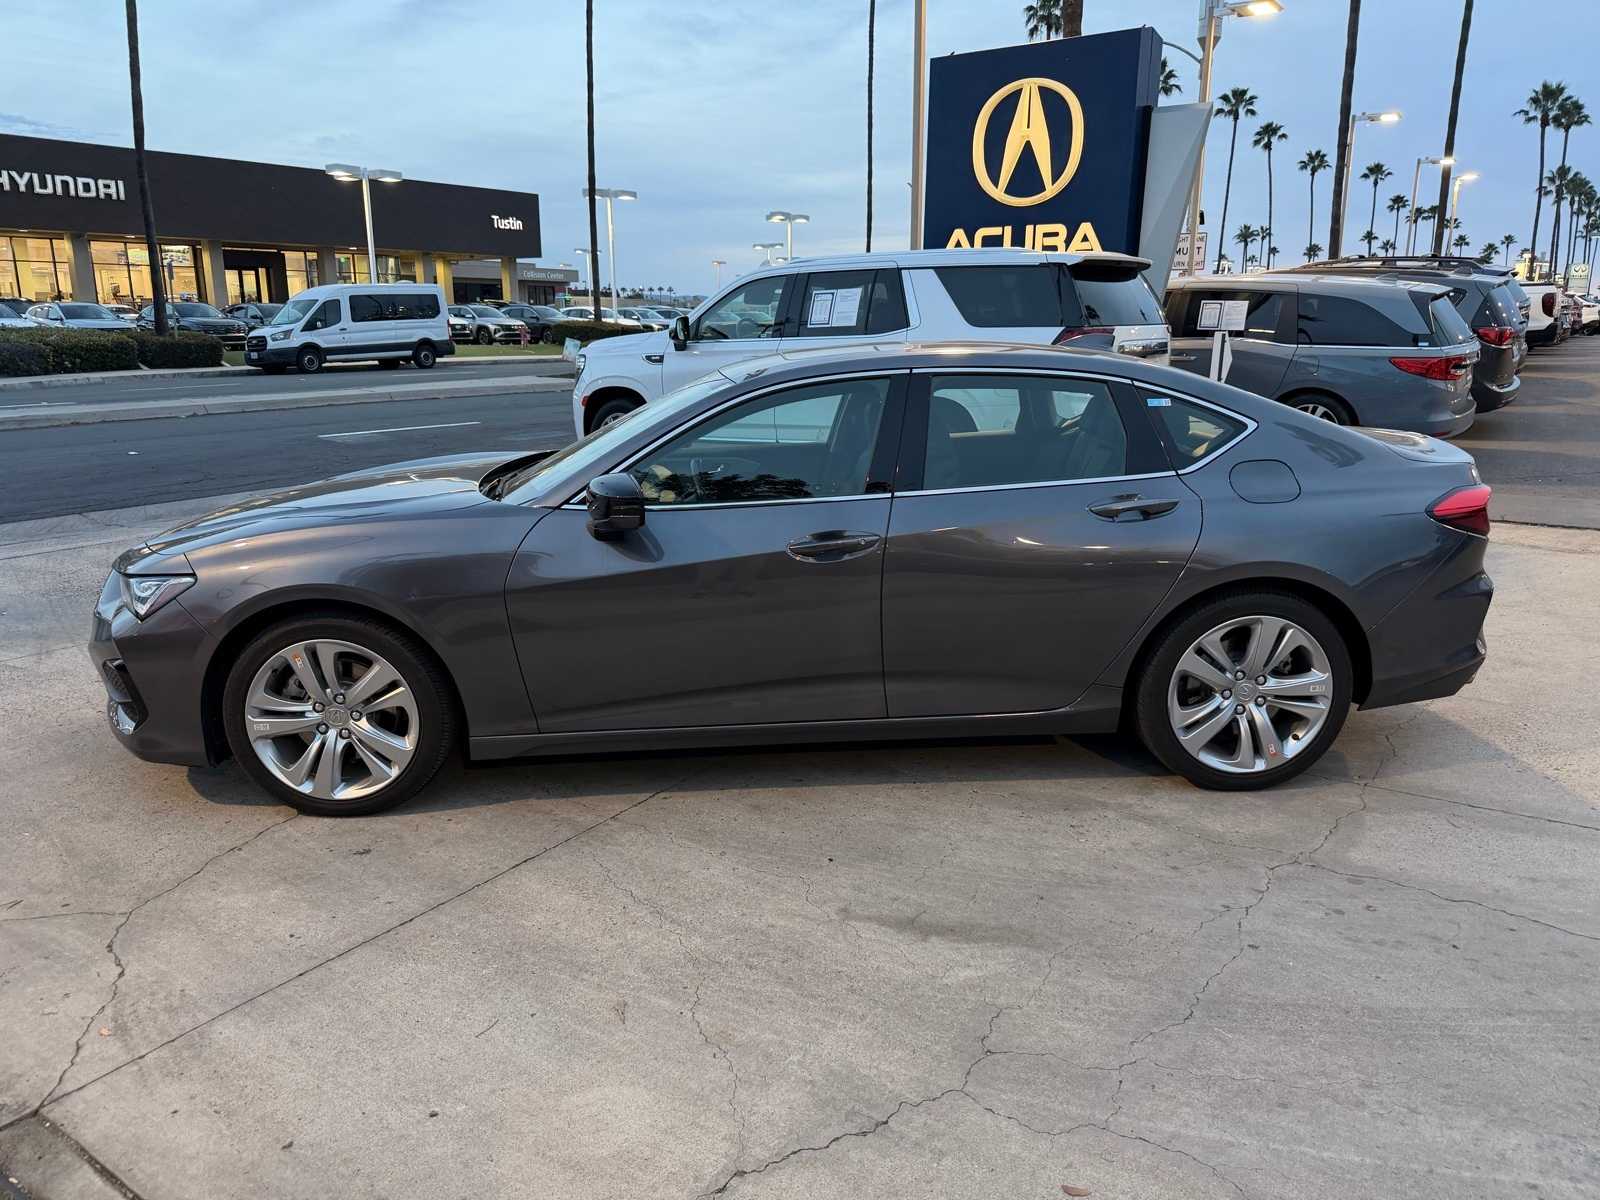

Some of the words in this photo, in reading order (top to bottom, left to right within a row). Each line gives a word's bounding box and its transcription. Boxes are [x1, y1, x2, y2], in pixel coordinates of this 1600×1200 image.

[491, 214, 523, 231] Tustin
[945, 222, 1103, 253] ACURA
[1176, 247, 1202, 255] MUT
